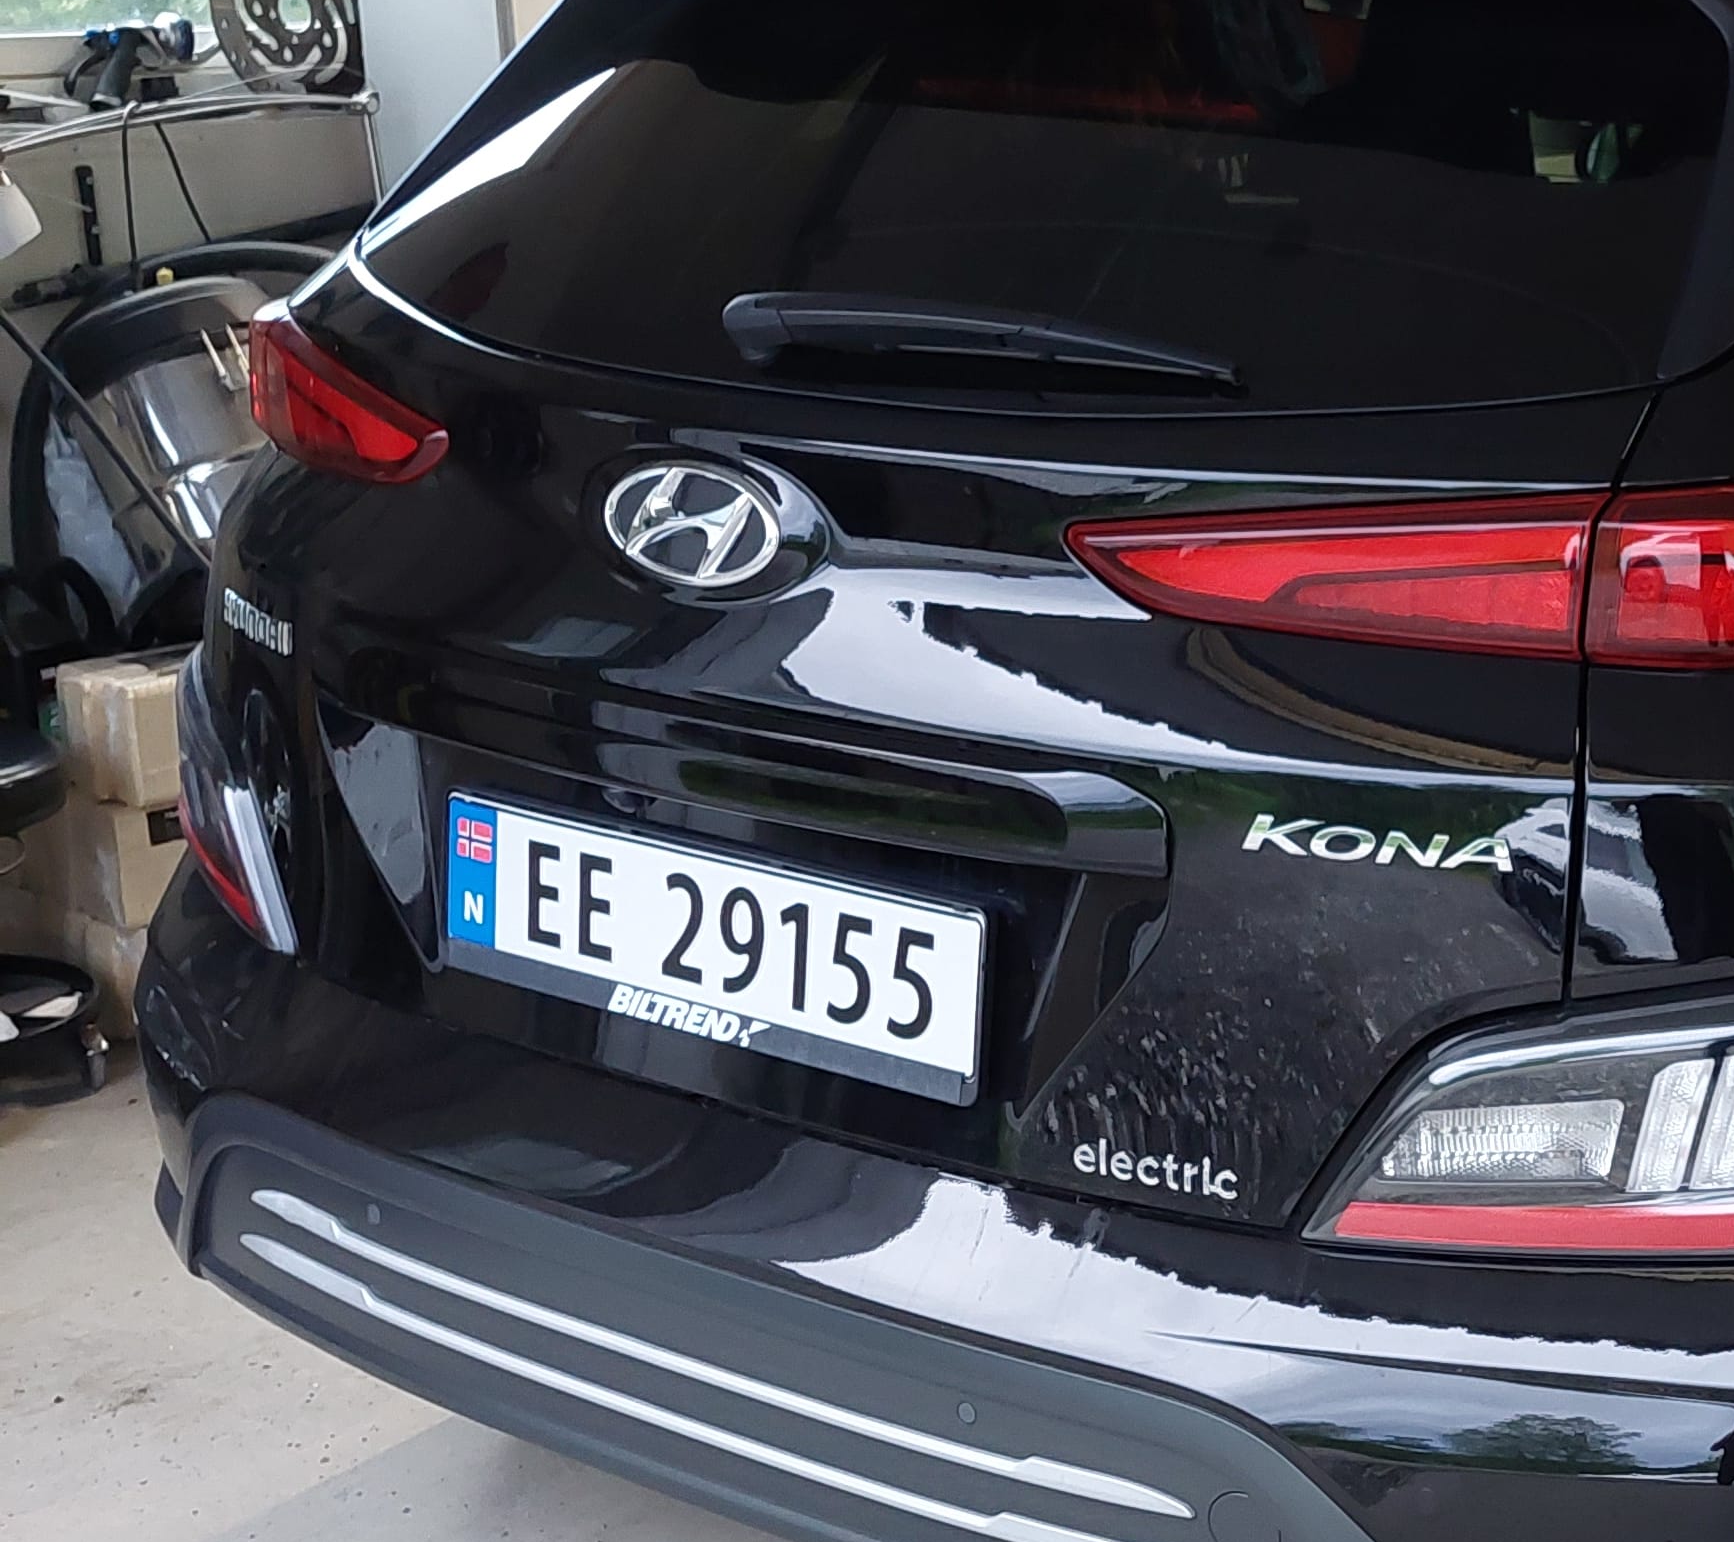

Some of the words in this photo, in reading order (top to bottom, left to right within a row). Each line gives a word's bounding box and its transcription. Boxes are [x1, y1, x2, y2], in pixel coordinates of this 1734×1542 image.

[1241, 812, 1514, 873] KONA
[463, 890, 484, 925] N
[527, 839, 613, 963] EE
[660, 871, 936, 1040] 29155
[606, 983, 741, 1043] BILTREND
[1072, 1137, 1239, 1201] electric
